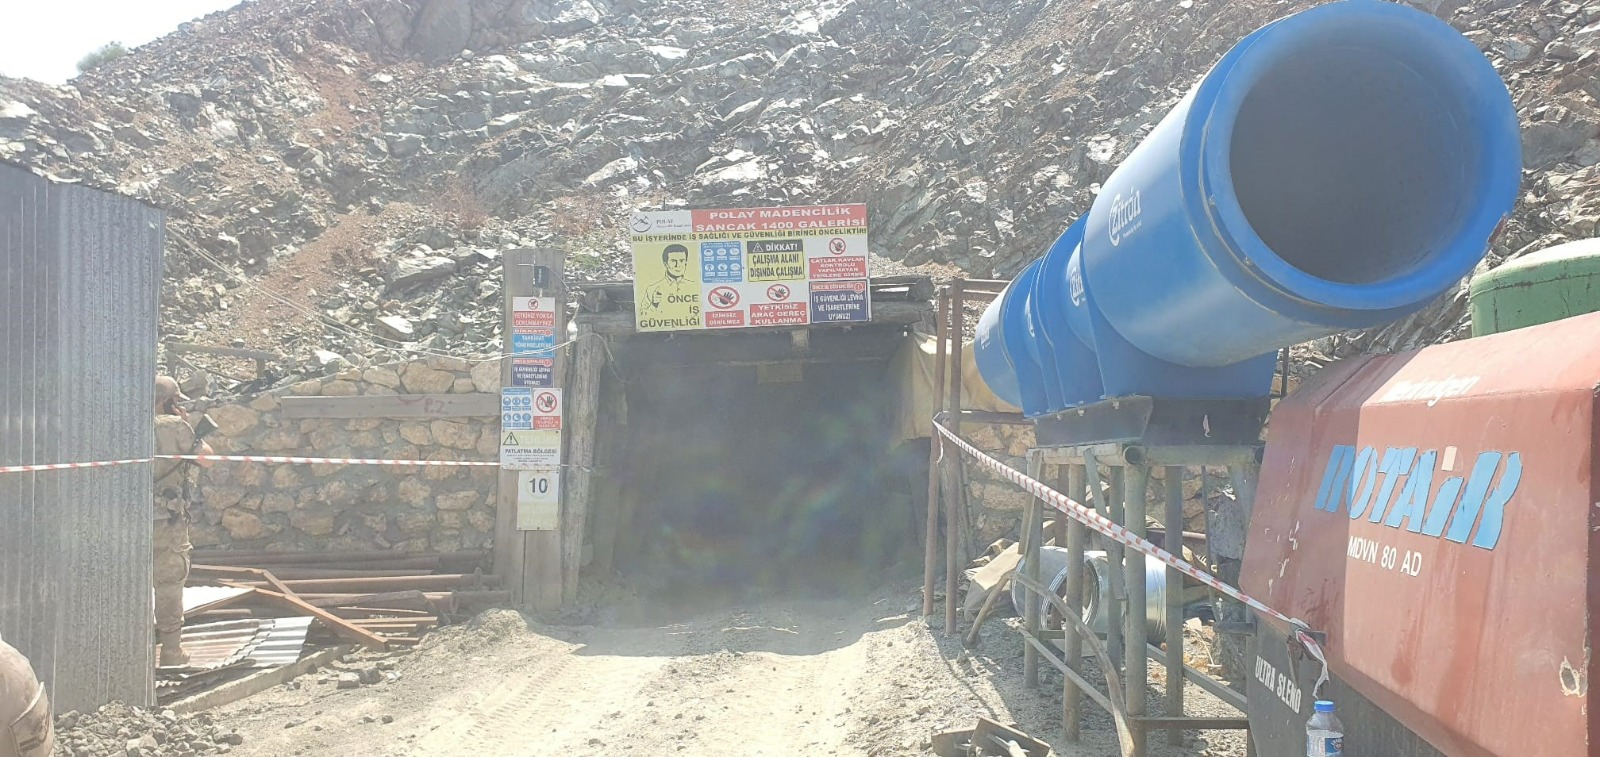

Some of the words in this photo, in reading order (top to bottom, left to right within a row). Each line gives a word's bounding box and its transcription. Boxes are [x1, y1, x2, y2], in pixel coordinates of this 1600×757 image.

[709, 211, 755, 219] POLAY
[760, 207, 851, 218] MADENCİLİK
[696, 222, 756, 232] SANCAK
[762, 221, 794, 229] 1400
[798, 217, 865, 228] GALERİSİ
[632, 234, 643, 242] BU
[645, 233, 687, 242] İŞYERİNDE
[689, 233, 697, 241] İŞ
[744, 229, 785, 238] GÜVENLİĞİ
[787, 228, 816, 236] BİRİNCİ
[765, 243, 798, 251] DİKKAT!
[753, 254, 779, 266] ÇALIŞMA
[781, 253, 799, 263] ALANI
[750, 267, 775, 279] DIŞINDA
[776, 266, 802, 279] ÇALIŞMA
[667, 293, 699, 303] ÖNCE
[689, 305, 699, 316] İŞ
[640, 317, 700, 328] GÜVENLİĞİ
[529, 478, 548, 493] 10
[1347, 535, 1378, 564] MDVN
[1381, 545, 1397, 570] 80
[1400, 549, 1422, 577] AD
[1255, 655, 1275, 692] ULTRA
